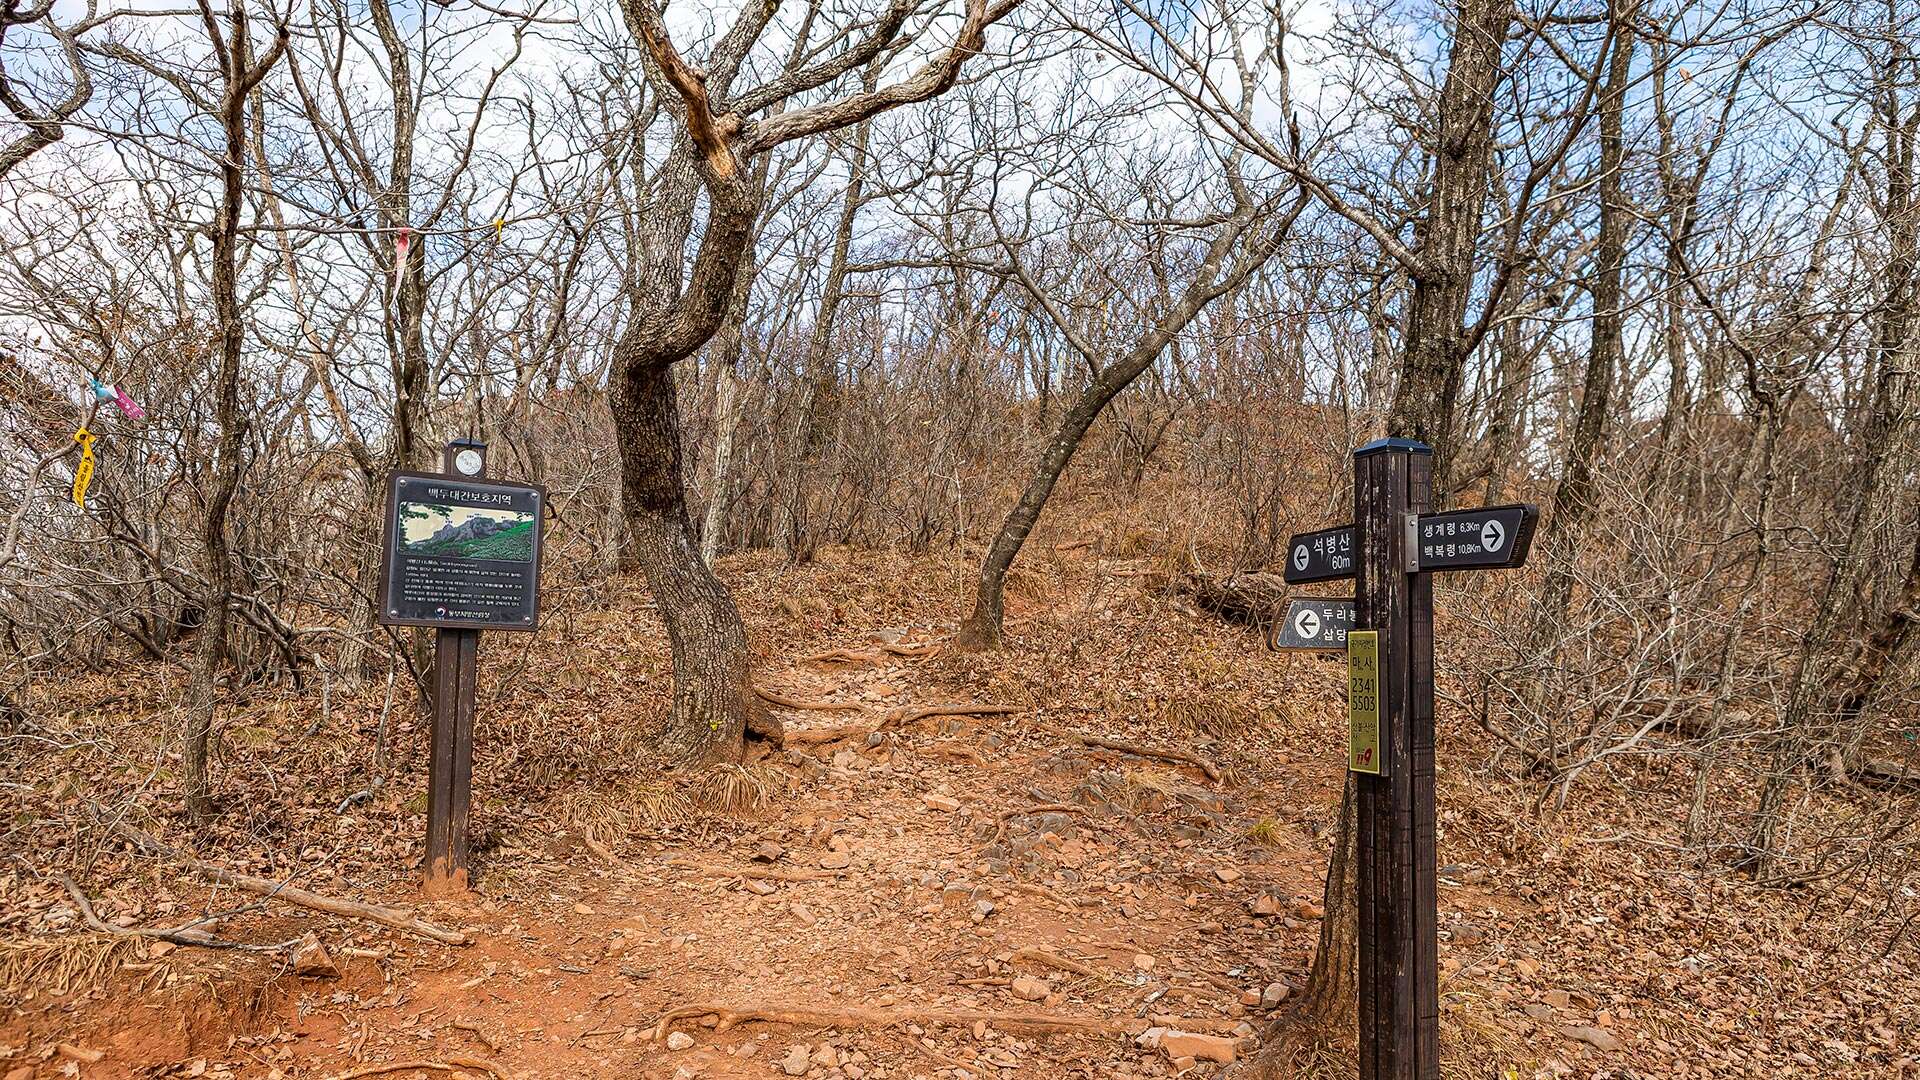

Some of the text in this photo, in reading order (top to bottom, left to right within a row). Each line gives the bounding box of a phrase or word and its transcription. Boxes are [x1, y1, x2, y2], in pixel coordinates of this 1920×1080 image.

[1424, 522, 1456, 538] 생계령
[1313, 533, 1351, 556] 석병산
[1424, 543, 1456, 558] 백복령
[1331, 555, 1351, 570] 60m
[1322, 628, 1347, 642] 삽당
[1352, 677, 1375, 693] 2341
[1352, 695, 1376, 711] 5503
[1356, 747, 1373, 766] 119
